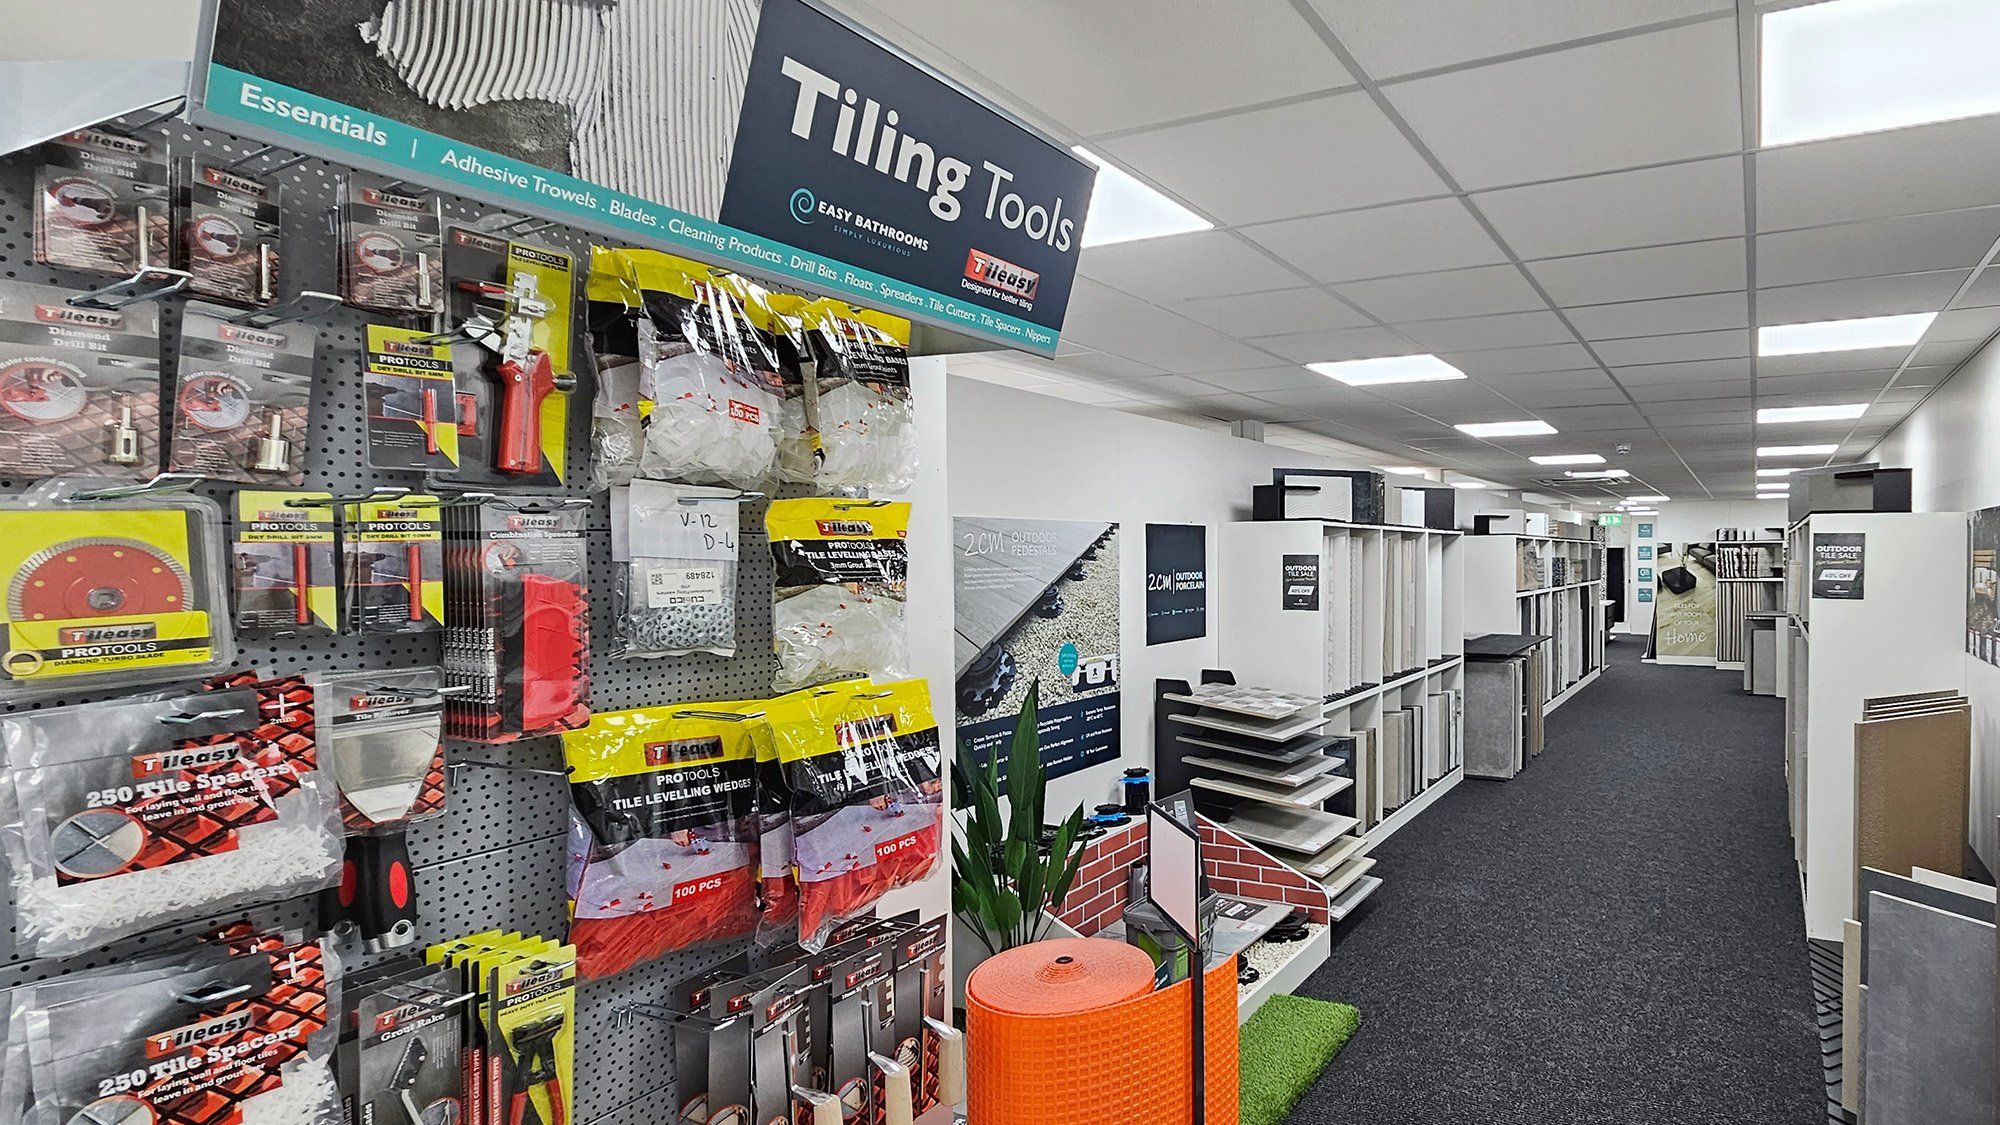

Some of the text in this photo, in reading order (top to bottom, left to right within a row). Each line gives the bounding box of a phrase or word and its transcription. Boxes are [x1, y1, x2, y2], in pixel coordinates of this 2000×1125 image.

[240, 82, 387, 146] Essentials
[79, 151, 138, 170] Diamond
[781, 56, 1074, 252] Tiling Tools
[83, 162, 135, 179] Drill Bit
[216, 190, 259, 210] Diamond
[219, 200, 256, 217] Drill Bit
[376, 208, 418, 223] Diamond
[379, 218, 417, 231] Drill Bit
[817, 200, 930, 251] EASY BATHROOMS
[440, 149, 1052, 344] Adhesive Trowels Blades Cleaning Products Drill Bits Floats Spreaders Tile Cutters Tile Spacers Nippers
[833, 225, 911, 257] SIMPLY LUXURIOUS
[515, 248, 564, 266] PROTOOLS
[972, 258, 1036, 293] Tileasy
[961, 278, 1033, 311] Designed for better tiling
[43, 308, 120, 327] Tileasy
[48, 326, 111, 342] Diamond
[225, 327, 284, 346] Tileasy
[52, 337, 107, 352] Drill Bit
[226, 344, 274, 360] Diamond
[228, 355, 271, 368] Drill Bit
[379, 355, 439, 369] PROTOOLS
[745, 411, 759, 423] PCS
[251, 523, 318, 531] PROTOOLS
[368, 522, 431, 531] PROTOOLS
[513, 517, 559, 527] Tileasy
[680, 512, 718, 528] V-12
[543, 531, 580, 539] Spreader
[702, 531, 735, 552] D-4
[1012, 531, 1057, 543] OUTDOOR
[827, 542, 873, 550] PROTOOLS
[963, 533, 1004, 556] 2CM
[1012, 545, 1057, 556] PEDESTALS
[805, 551, 871, 560] TILE LEVELLING
[830, 561, 847, 570] 3mm
[685, 571, 715, 580] 128489
[1148, 573, 1171, 590] 2CM
[1176, 571, 1203, 581] OUTDOOR
[1176, 581, 1204, 590] PORCELAIN
[71, 625, 151, 641] Tileasy
[486, 627, 494, 650] Notch
[1664, 628, 1707, 645] Home
[61, 642, 157, 658] PROTOOLS
[54, 652, 165, 667] DIAMOND TURBO BLADE
[269, 714, 297, 725] 2mm
[143, 745, 240, 772] Tileasy
[656, 767, 721, 786] PROTOOLS
[817, 769, 842, 784] TILE
[85, 763, 291, 809] 250 Tile Spacers
[612, 778, 752, 811] TILE LEVELLING WEDGES
[124, 786, 250, 815] For laying wall and floor
[142, 794, 259, 822] leave in and grout over
[876, 836, 917, 859] 100 PCS
[673, 877, 723, 899] 100 PCS
[507, 983, 561, 1006] PROTOOLS
[157, 1012, 252, 1051] Tileasy
[380, 1013, 446, 1041] Grout Rake
[98, 1024, 300, 1097] 250 Tile Spacers
[137, 1048, 278, 1100] For laying wall and floor tiles
[153, 1062, 266, 1104] leave in and grout over
